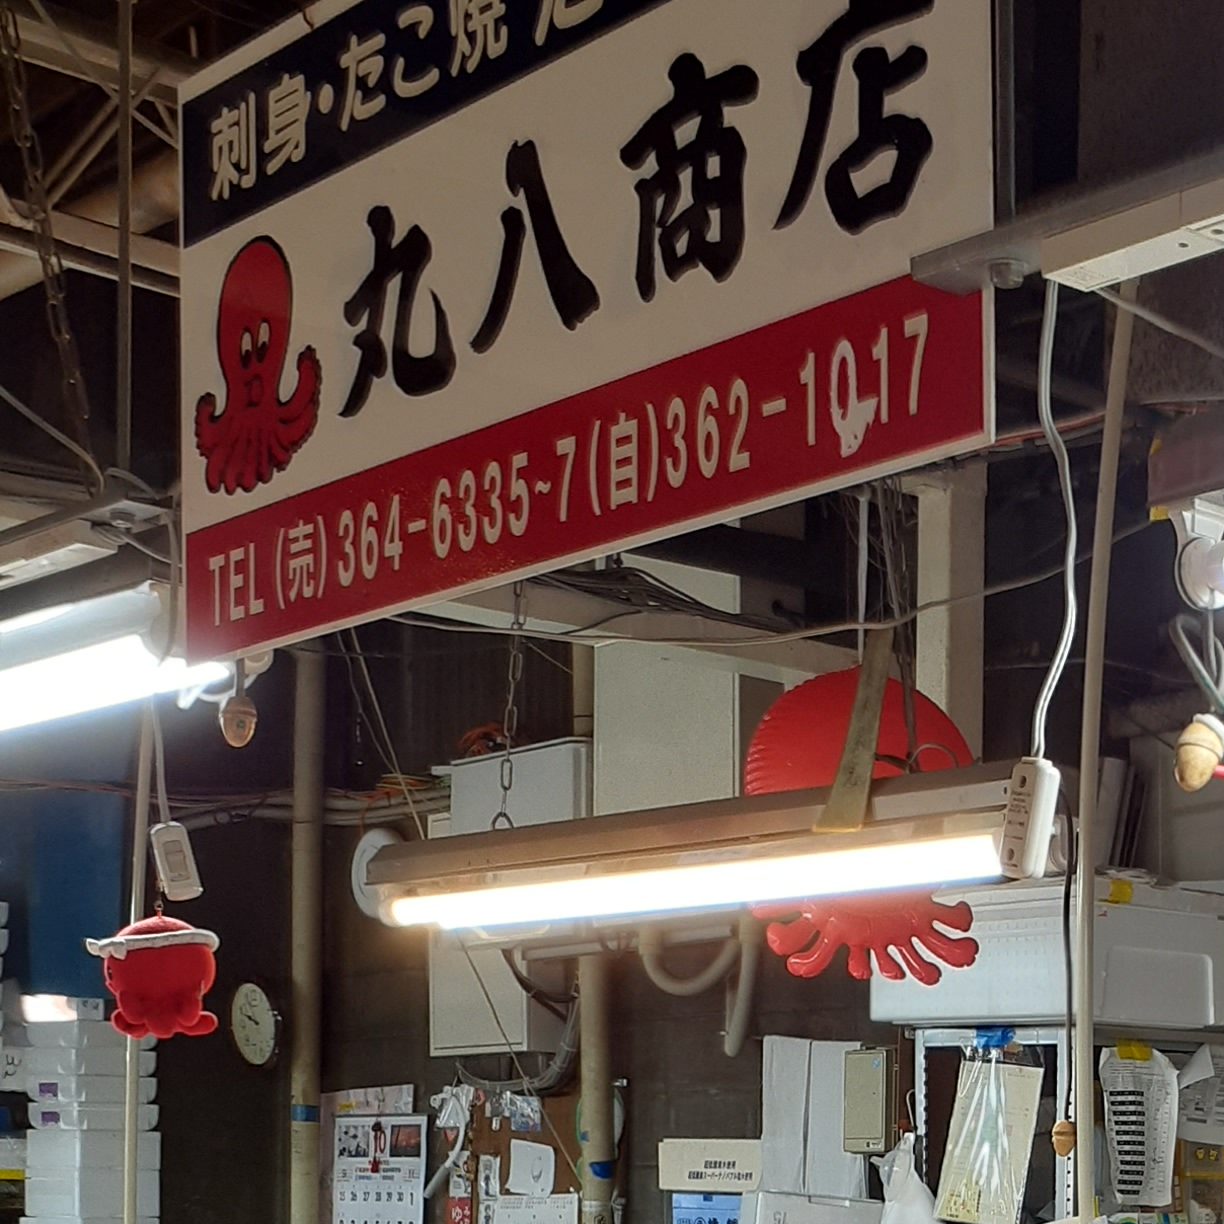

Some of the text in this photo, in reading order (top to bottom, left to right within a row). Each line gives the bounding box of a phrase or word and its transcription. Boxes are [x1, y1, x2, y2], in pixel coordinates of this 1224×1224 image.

[340, 0, 936, 418] 丸八商店
[208, 541, 265, 627] TEL
